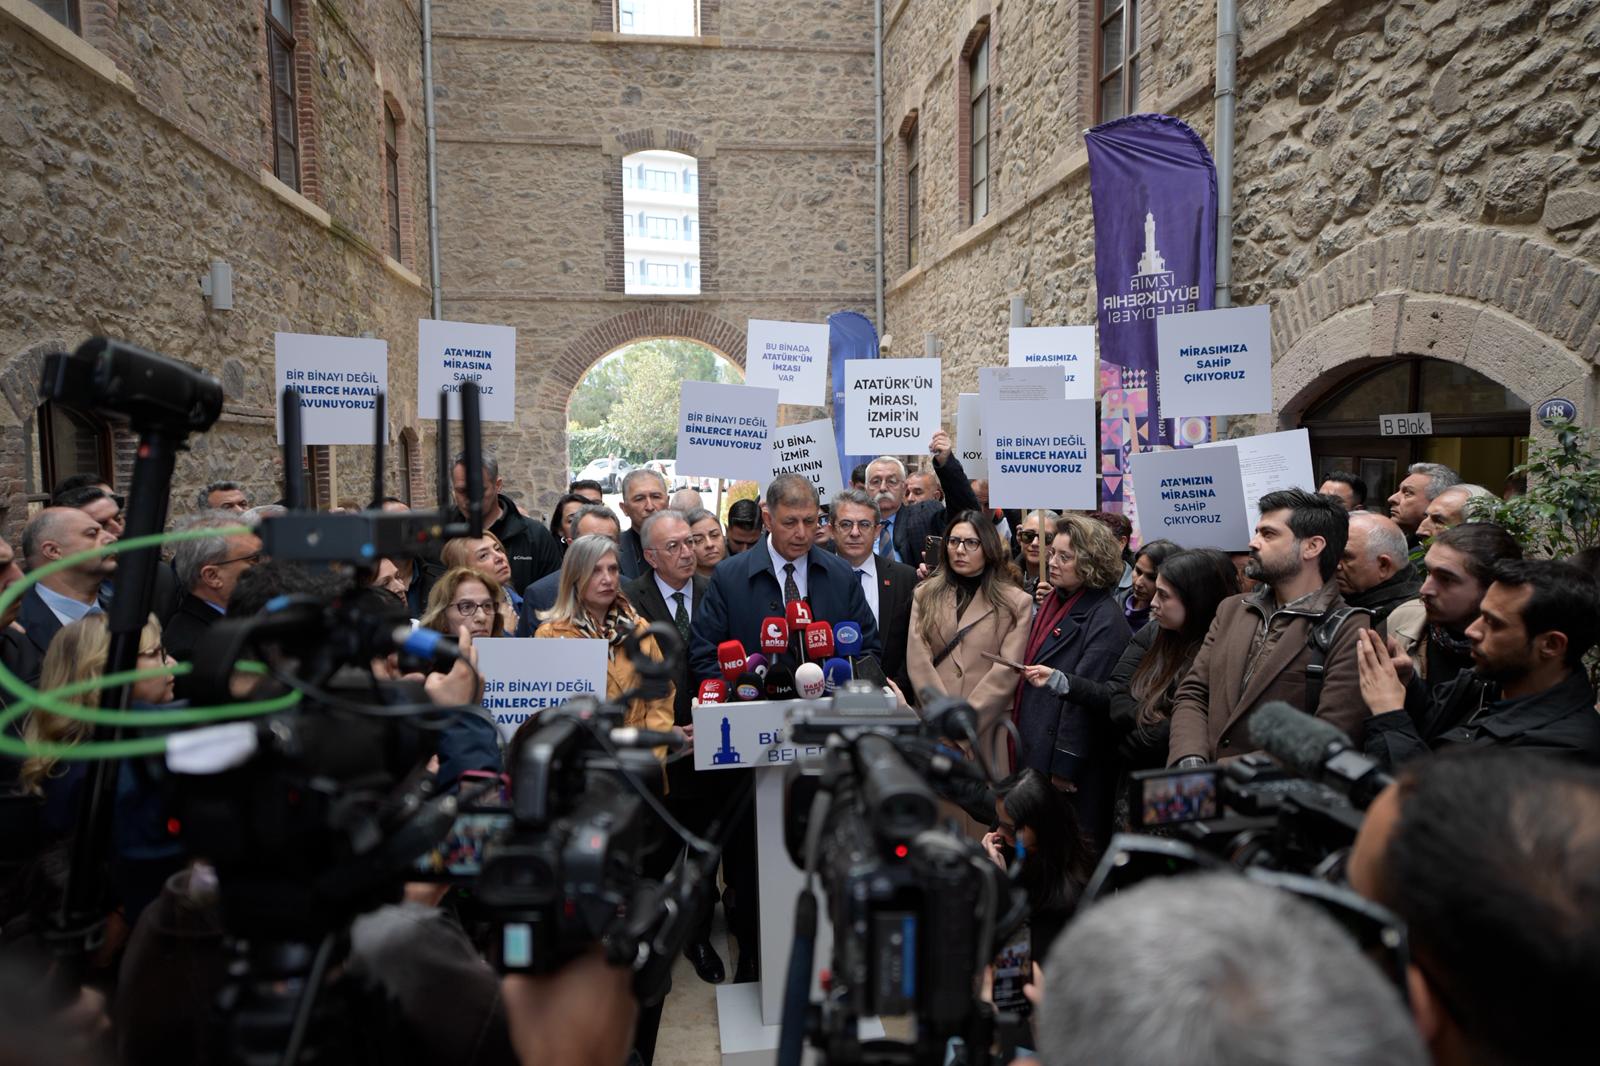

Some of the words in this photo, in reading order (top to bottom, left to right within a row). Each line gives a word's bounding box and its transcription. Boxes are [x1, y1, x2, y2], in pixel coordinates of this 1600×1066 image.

[766, 342, 776, 350] BU
[779, 344, 810, 352] BİNADA
[1180, 344, 1248, 357] MİRASIMIZA
[444, 358, 492, 370] MİRASINA
[1026, 354, 1078, 362] MİRASIMIZA
[1197, 356, 1231, 368] SAHİP
[772, 362, 800, 372] İMZASI
[286, 368, 304, 380] BİR
[308, 370, 343, 382] BİNAYI
[347, 372, 378, 383] DEĞİL
[453, 372, 482, 381] SAHİP
[1184, 370, 1245, 384] ÇIKIYORUZ
[298, 399, 375, 409] AVUNUYORUZ
[870, 392, 917, 406] MİRASI,
[1546, 406, 1564, 418] 138
[687, 411, 703, 422] BİR
[706, 413, 737, 424] BİNAYI
[739, 417, 768, 427] DEĞİL
[686, 423, 732, 436] BİNLERCE
[734, 428, 768, 439] HAYALİ
[1384, 420, 1393, 434] B
[1398, 417, 1426, 434] Blok
[869, 427, 920, 438] TAPUSU
[689, 437, 762, 450] SAVUNUYORUZ
[787, 435, 816, 447] BİNA,
[996, 436, 1013, 447] BİR
[1016, 436, 1050, 446] BİNAYI
[1053, 434, 1086, 446] DEĞİL
[781, 448, 809, 461] İZMİR
[996, 449, 1046, 460] BİNLERCE
[1049, 448, 1087, 459] HAYALİ
[772, 460, 823, 476] HALKININ
[1001, 464, 1082, 473] SAVUNUYORUZ
[1162, 489, 1216, 500] MİRASINA
[1174, 501, 1206, 512] SAHİP
[1164, 515, 1221, 526] ÇIKIYORUZ
[724, 659, 744, 670] NEO
[484, 680, 504, 692] BİR
[508, 679, 551, 692] BİNAYI
[556, 679, 595, 692] DEĞİL
[482, 695, 546, 708] BİNLERCE
